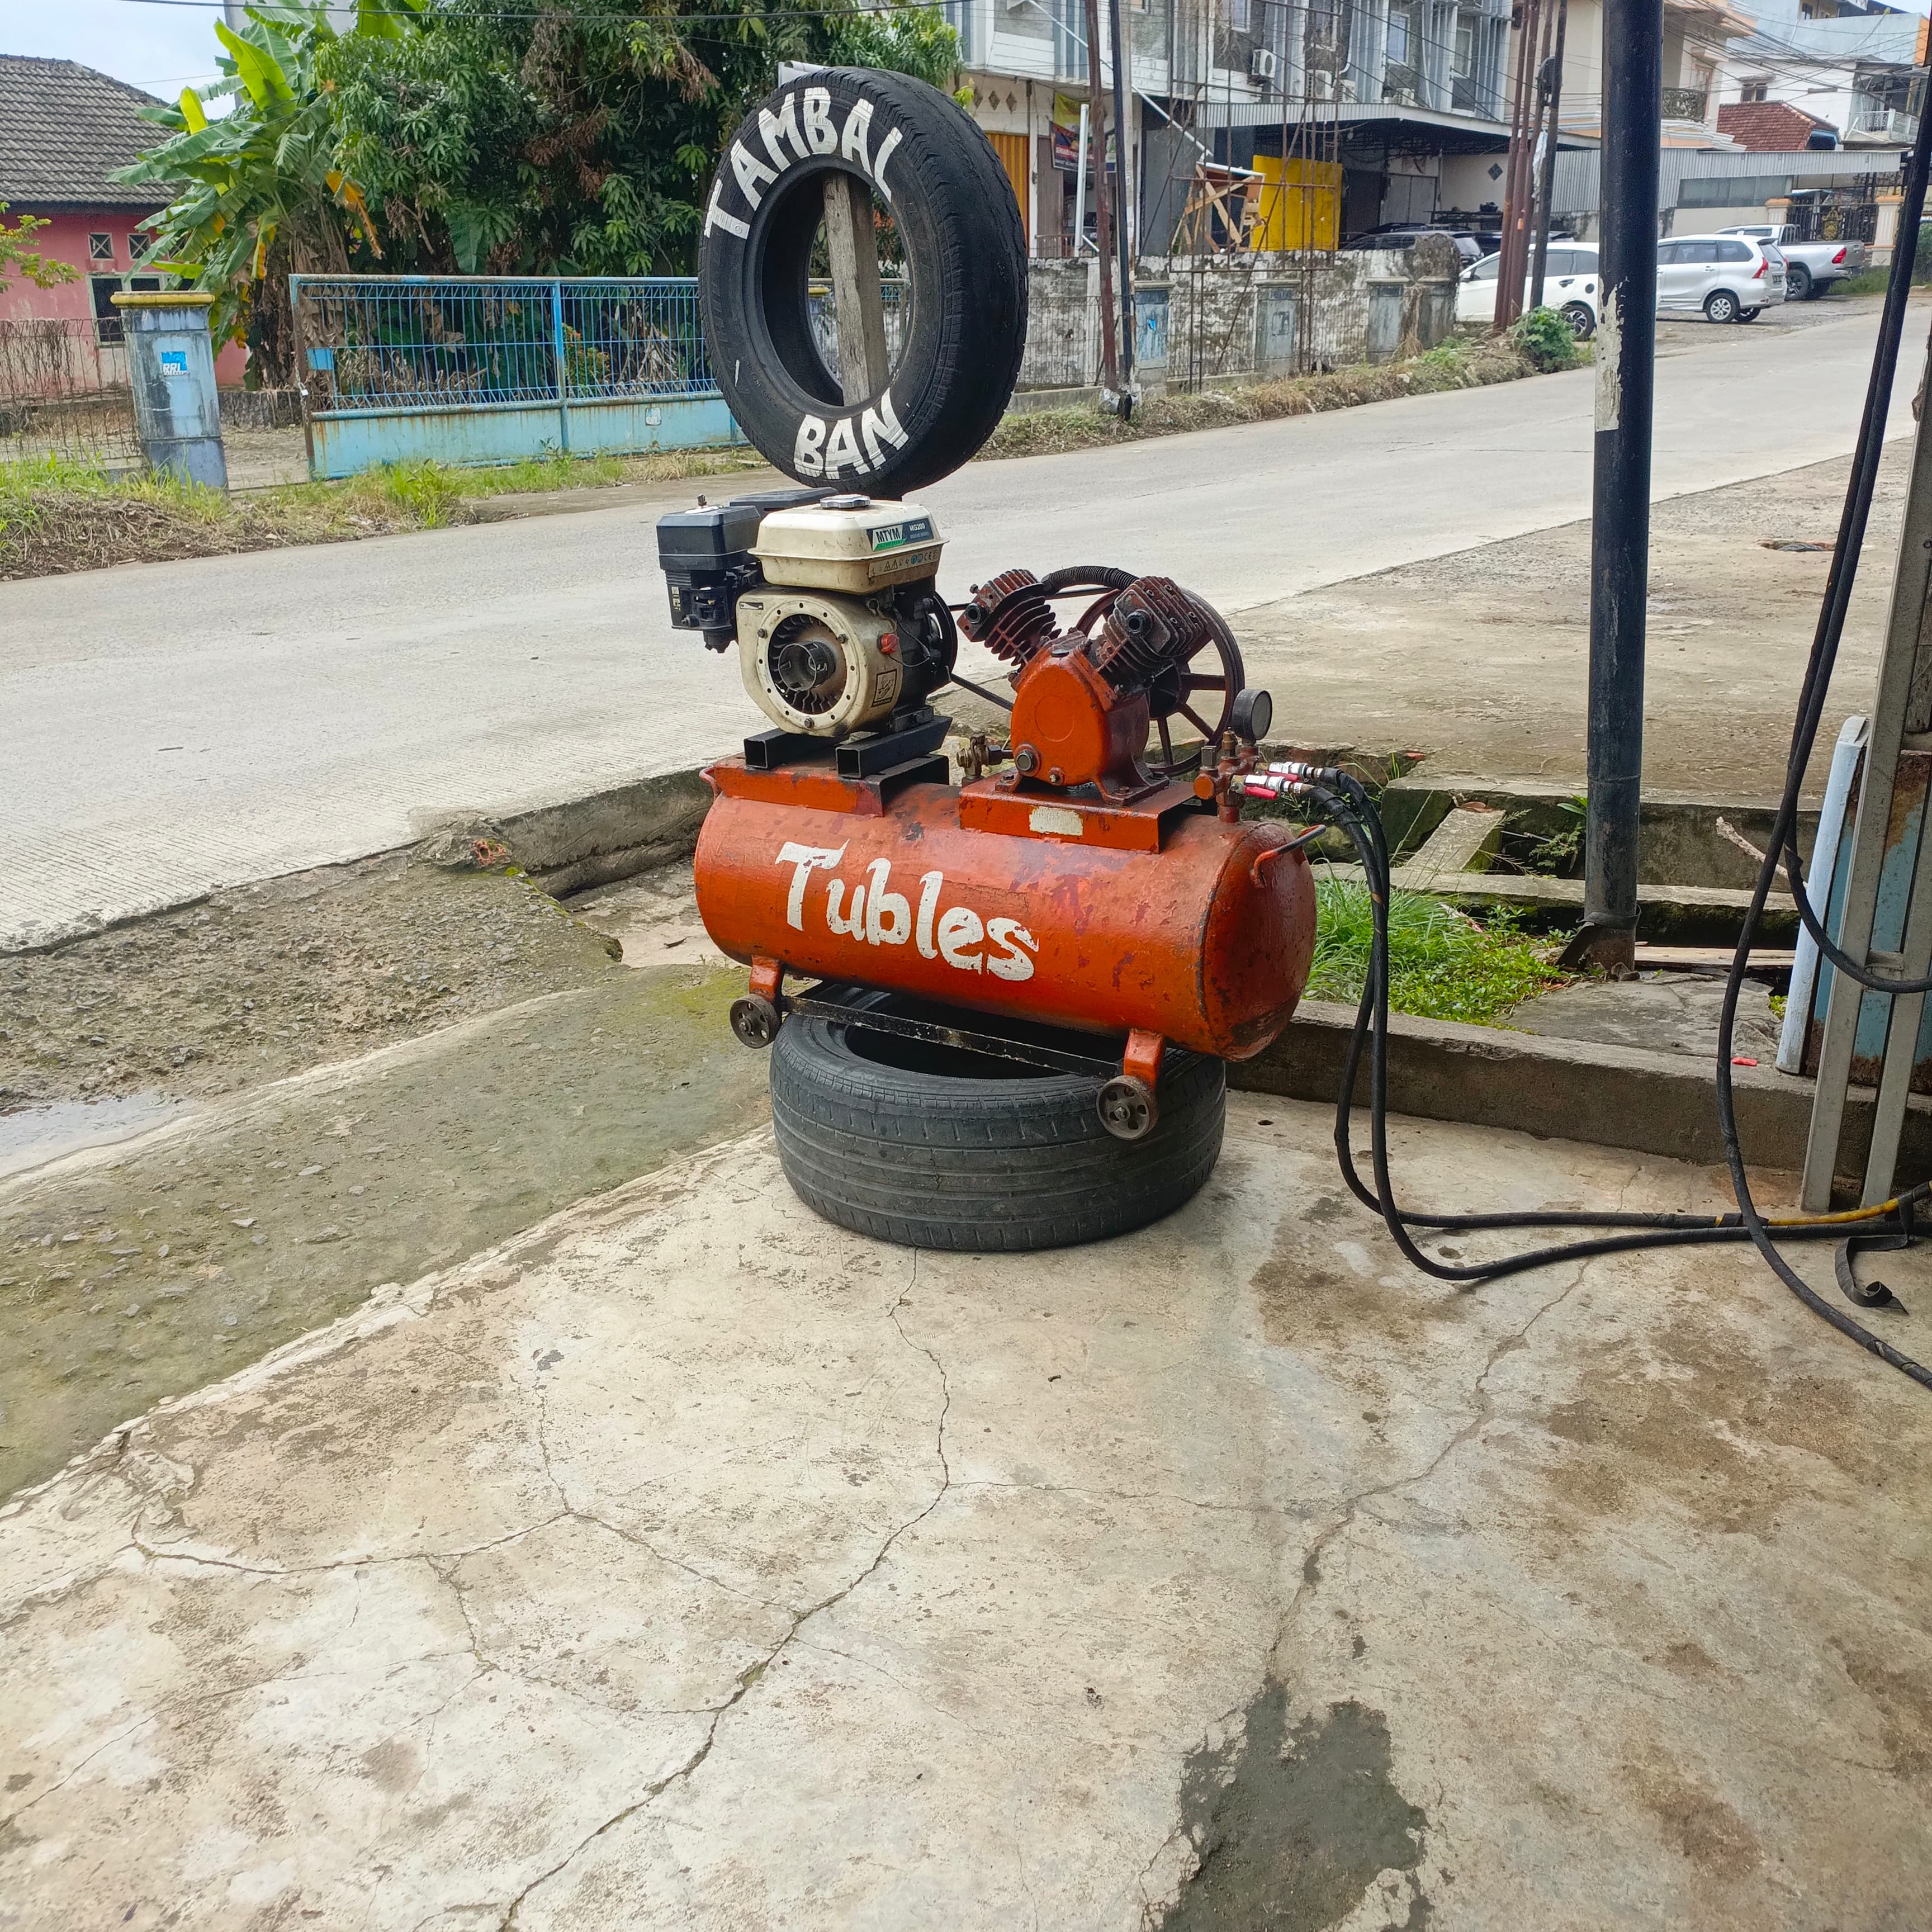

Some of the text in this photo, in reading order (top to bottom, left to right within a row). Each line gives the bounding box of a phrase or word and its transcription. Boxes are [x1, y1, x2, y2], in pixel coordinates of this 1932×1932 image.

[703, 87, 903, 240] TAMBAL
[794, 387, 909, 480] BAN
[875, 528, 901, 543] MTYM
[909, 523, 925, 531] MG200
[775, 839, 1039, 982] Tubles
